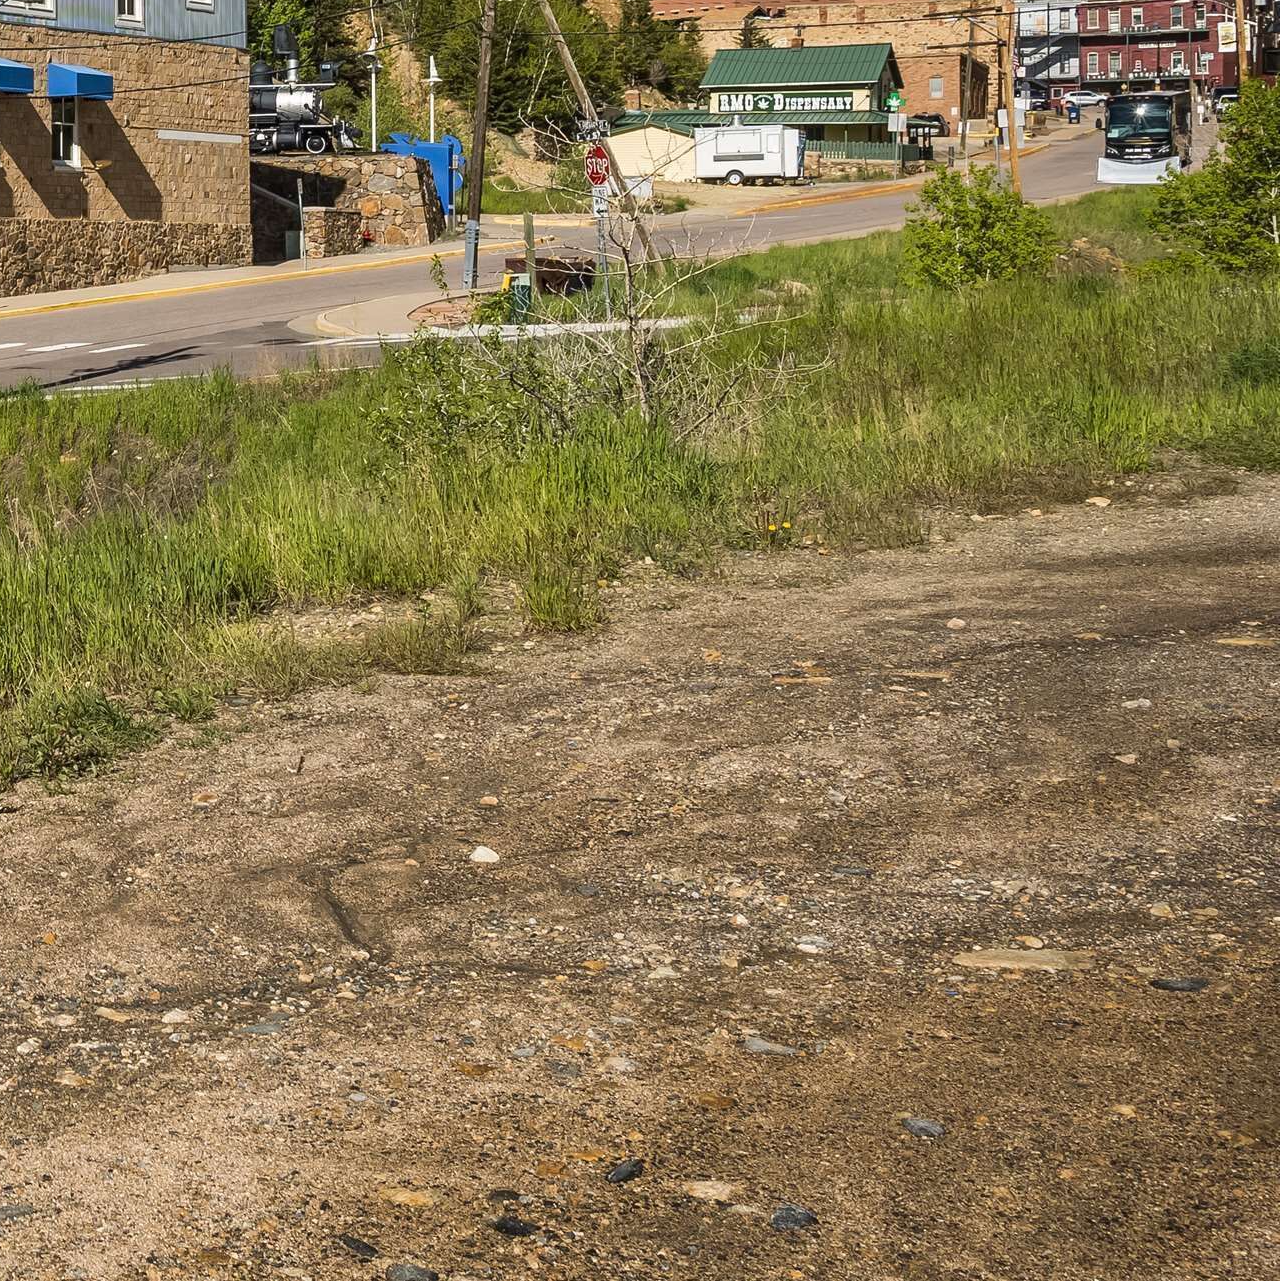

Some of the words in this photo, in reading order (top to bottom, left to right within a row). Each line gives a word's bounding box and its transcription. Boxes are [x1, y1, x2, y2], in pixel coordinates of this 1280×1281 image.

[719, 94, 754, 111] RMO
[773, 94, 852, 111] DISPENSARY
[586, 158, 608, 175] STOP
